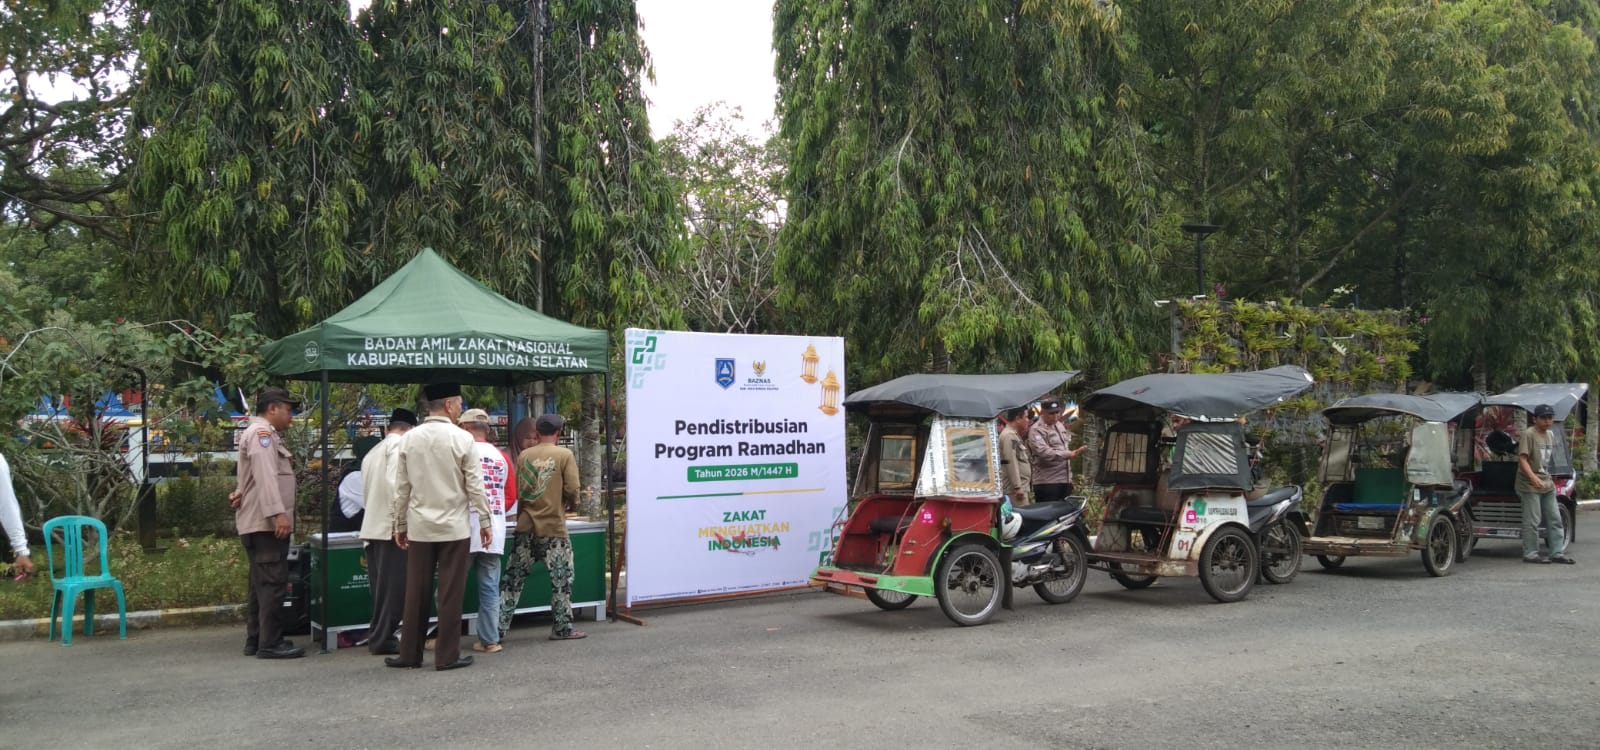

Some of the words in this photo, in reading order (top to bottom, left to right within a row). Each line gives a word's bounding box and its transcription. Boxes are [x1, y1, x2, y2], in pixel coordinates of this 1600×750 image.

[364, 337, 416, 351] BADAN
[420, 337, 455, 352] AMIL
[459, 338, 502, 353] ZAKAT
[507, 340, 573, 355] NASIONAL
[347, 351, 434, 366] KABUPATEN
[438, 352, 475, 366] HULU
[478, 352, 529, 367] SUNGAI
[532, 355, 588, 369] SELATAN
[675, 419, 808, 435] Pendistribusian
[655, 442, 733, 461] Program
[738, 440, 825, 457] Ramadhan
[695, 469, 722, 478] Tahun
[725, 468, 748, 477] 2026
[750, 466, 783, 476] M/1447
[786, 467, 792, 475] H
[723, 510, 766, 523] ZAKAT
[698, 523, 790, 538] MENGUATKAN
[708, 535, 781, 551] INDONESIA
[1178, 540, 1189, 551] 01
